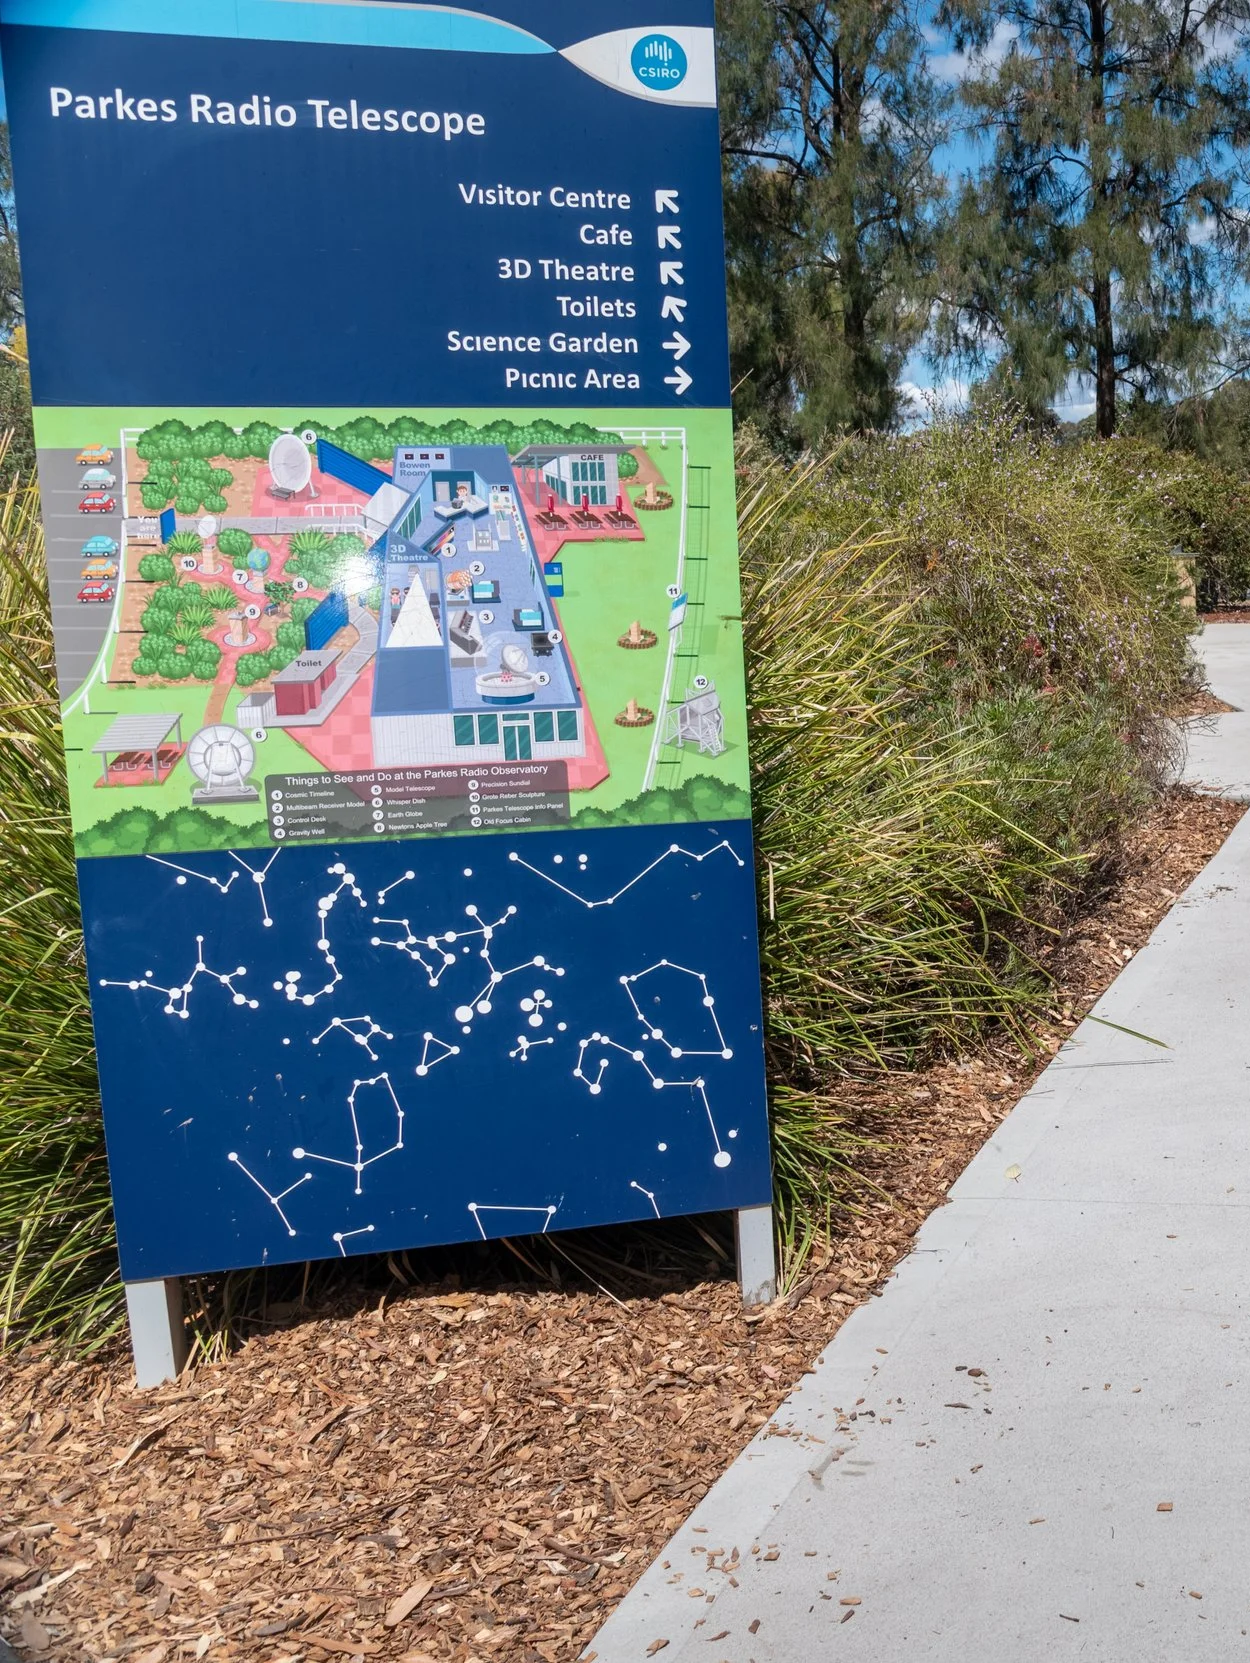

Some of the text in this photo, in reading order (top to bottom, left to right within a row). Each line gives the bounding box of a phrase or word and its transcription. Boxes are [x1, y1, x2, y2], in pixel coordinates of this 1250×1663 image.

[638, 66, 680, 79] CSIRO
[50, 87, 485, 141] Parkes Radio Telescope
[458, 183, 631, 210] Visitor Centre
[579, 223, 633, 246] Cafe
[498, 258, 635, 282] 3D Theatre
[556, 295, 637, 318] Toilets
[447, 331, 638, 353] Science Garden
[505, 367, 641, 389] Picnic Area
[305, 433, 312, 441] 6
[399, 461, 431, 469] Bowen
[400, 469, 426, 477] Room
[390, 544, 406, 553] 3D
[390, 554, 429, 562] Theatre
[183, 560, 195, 568] 10
[236, 573, 243, 581] 7
[249, 608, 256, 616] 9
[483, 613, 490, 621] 3
[539, 675, 546, 683] 5
[696, 678, 706, 686] 12
[255, 731, 263, 739] 6
[285, 765, 549, 787] Things to See and Do at the Parkes Radio Observatory
